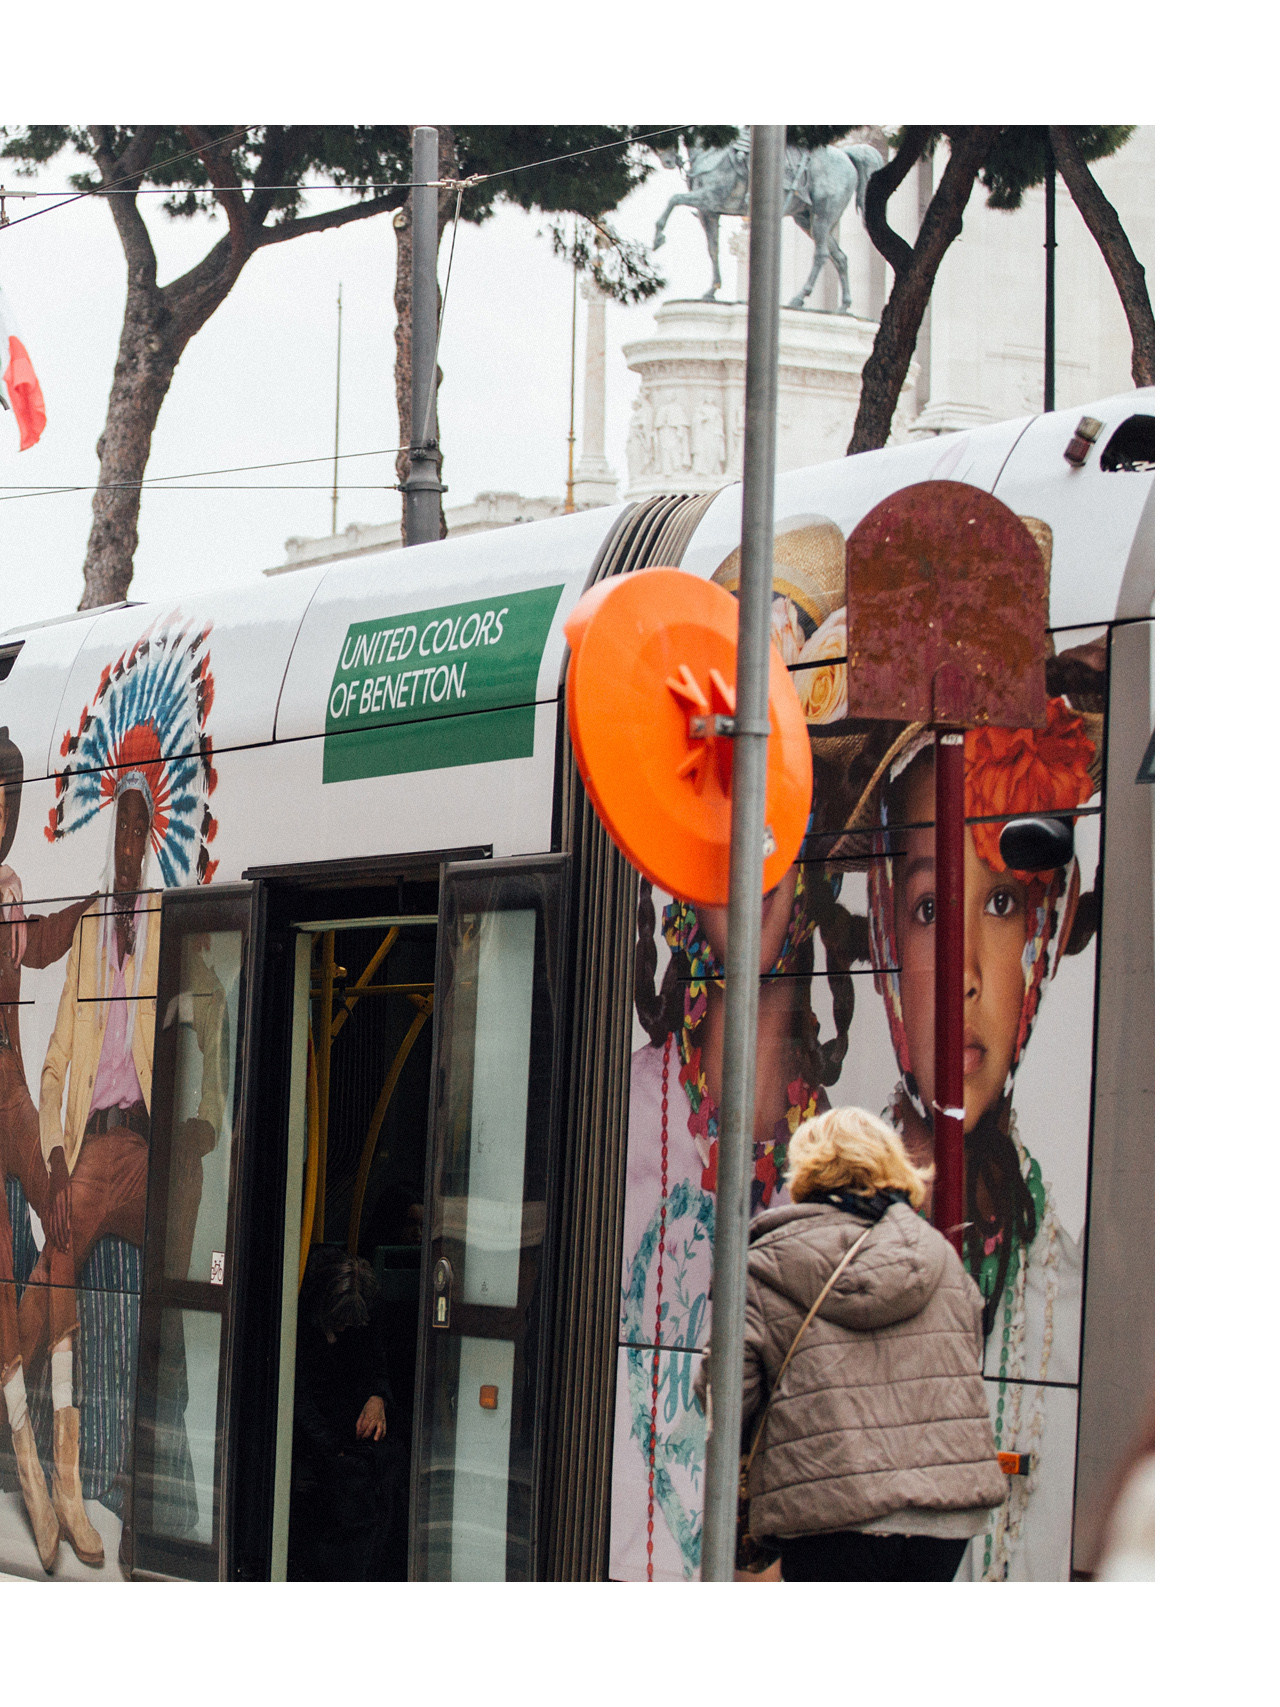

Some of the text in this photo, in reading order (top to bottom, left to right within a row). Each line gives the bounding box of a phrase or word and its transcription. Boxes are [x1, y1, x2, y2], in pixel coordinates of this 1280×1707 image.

[341, 608, 509, 670] UNITED COLORS
[330, 662, 468, 719] OF BENETTON.
